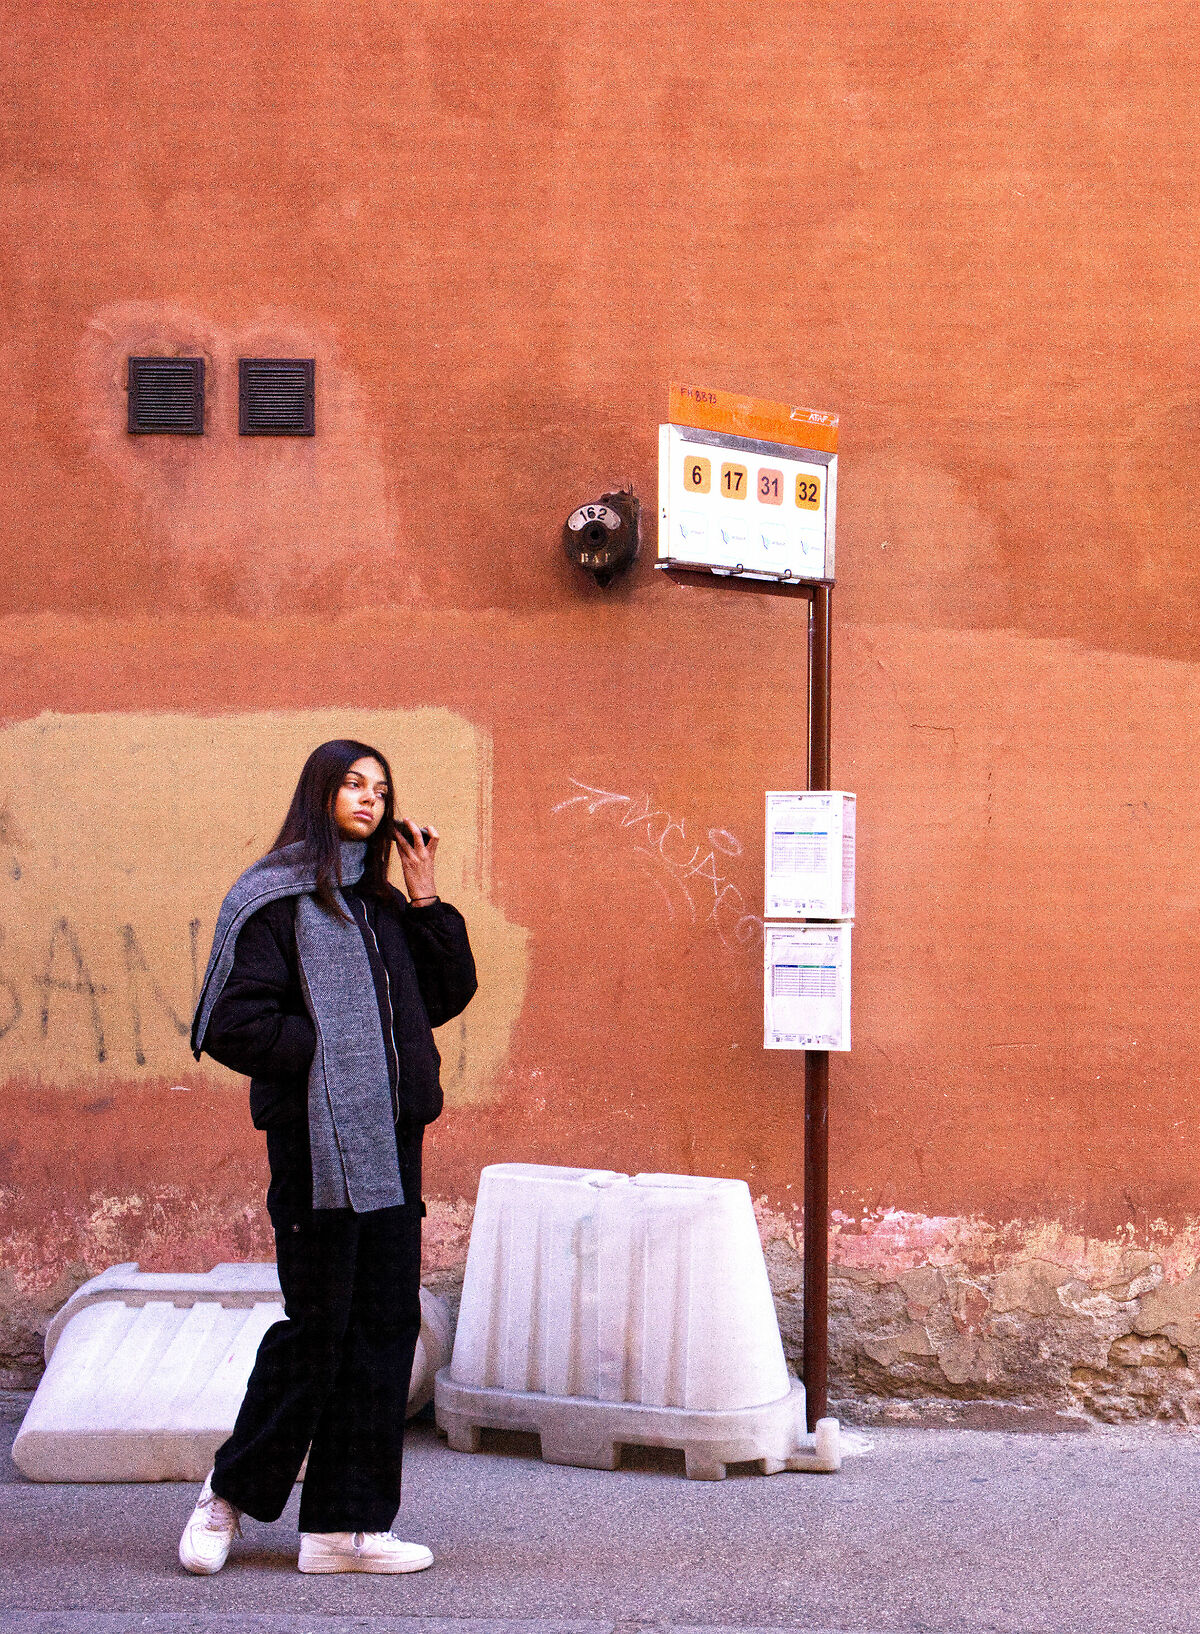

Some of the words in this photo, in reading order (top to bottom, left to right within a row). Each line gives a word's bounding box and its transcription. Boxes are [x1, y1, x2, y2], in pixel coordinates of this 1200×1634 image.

[691, 465, 702, 485] 6
[724, 470, 743, 491] 17
[761, 476, 779, 497] 31
[798, 481, 818, 503] 32
[579, 506, 608, 522] 162
